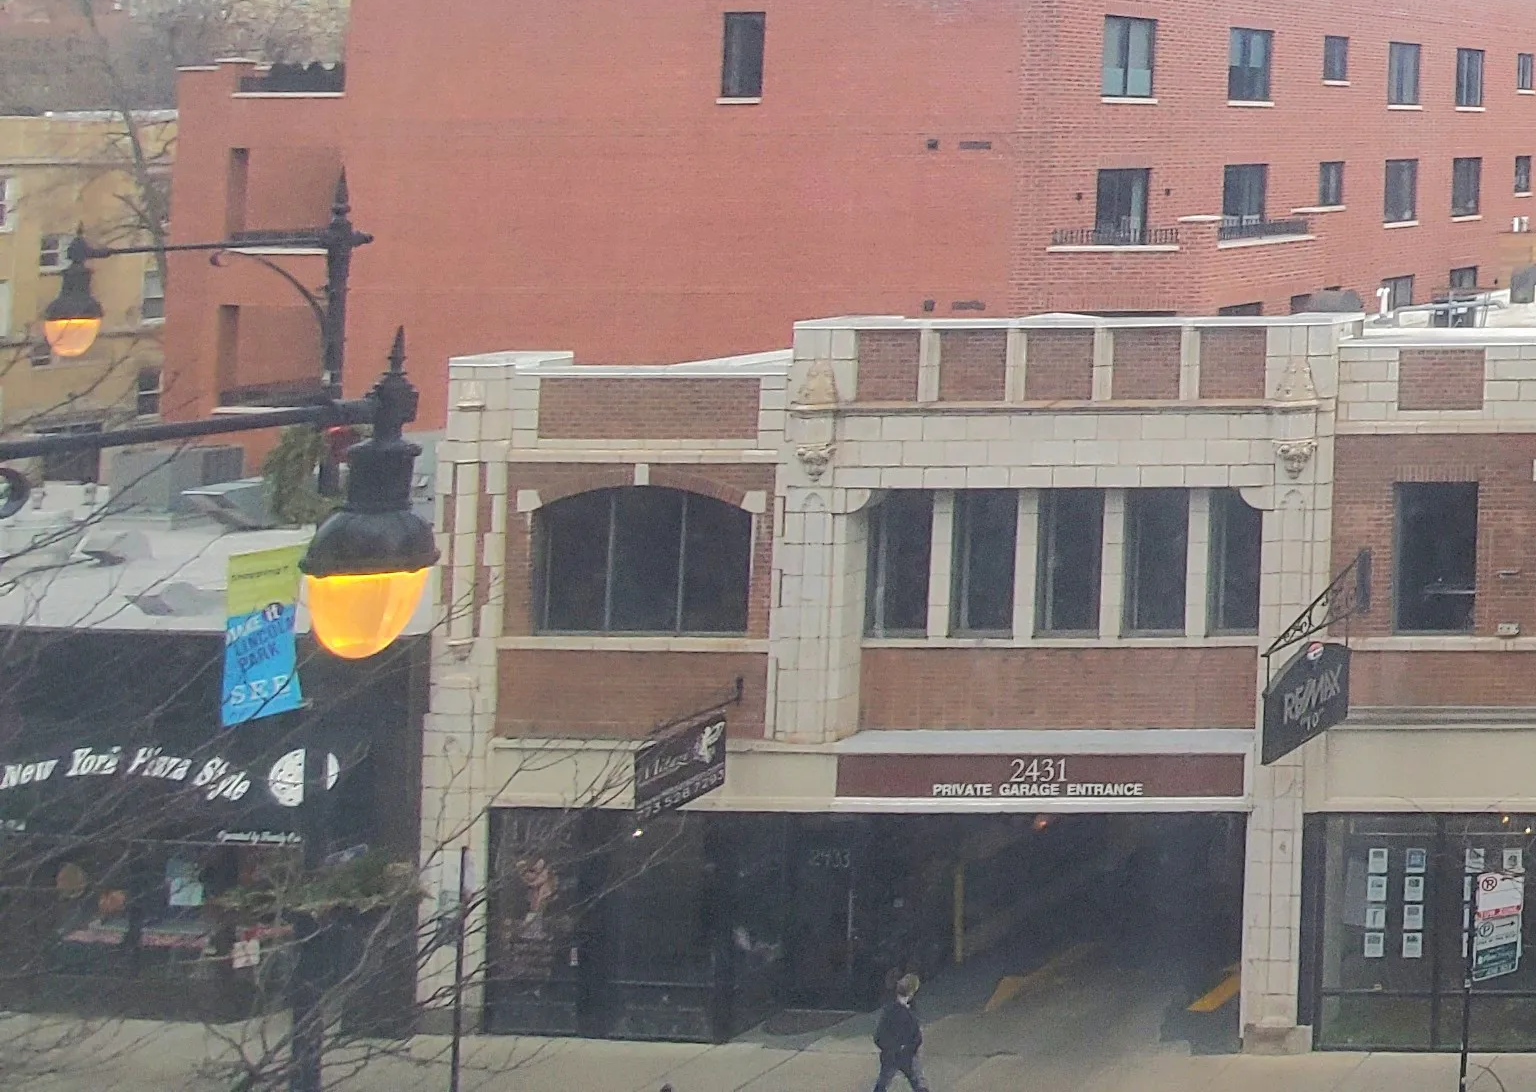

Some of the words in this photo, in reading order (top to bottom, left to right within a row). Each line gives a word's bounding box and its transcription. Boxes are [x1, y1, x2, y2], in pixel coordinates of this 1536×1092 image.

[0, 759, 58, 790] New
[1009, 758, 1068, 783] 2431
[932, 783, 993, 796] PRIVATE
[999, 783, 1060, 796] GARAGE
[1066, 783, 1144, 796] ENTRANCE
